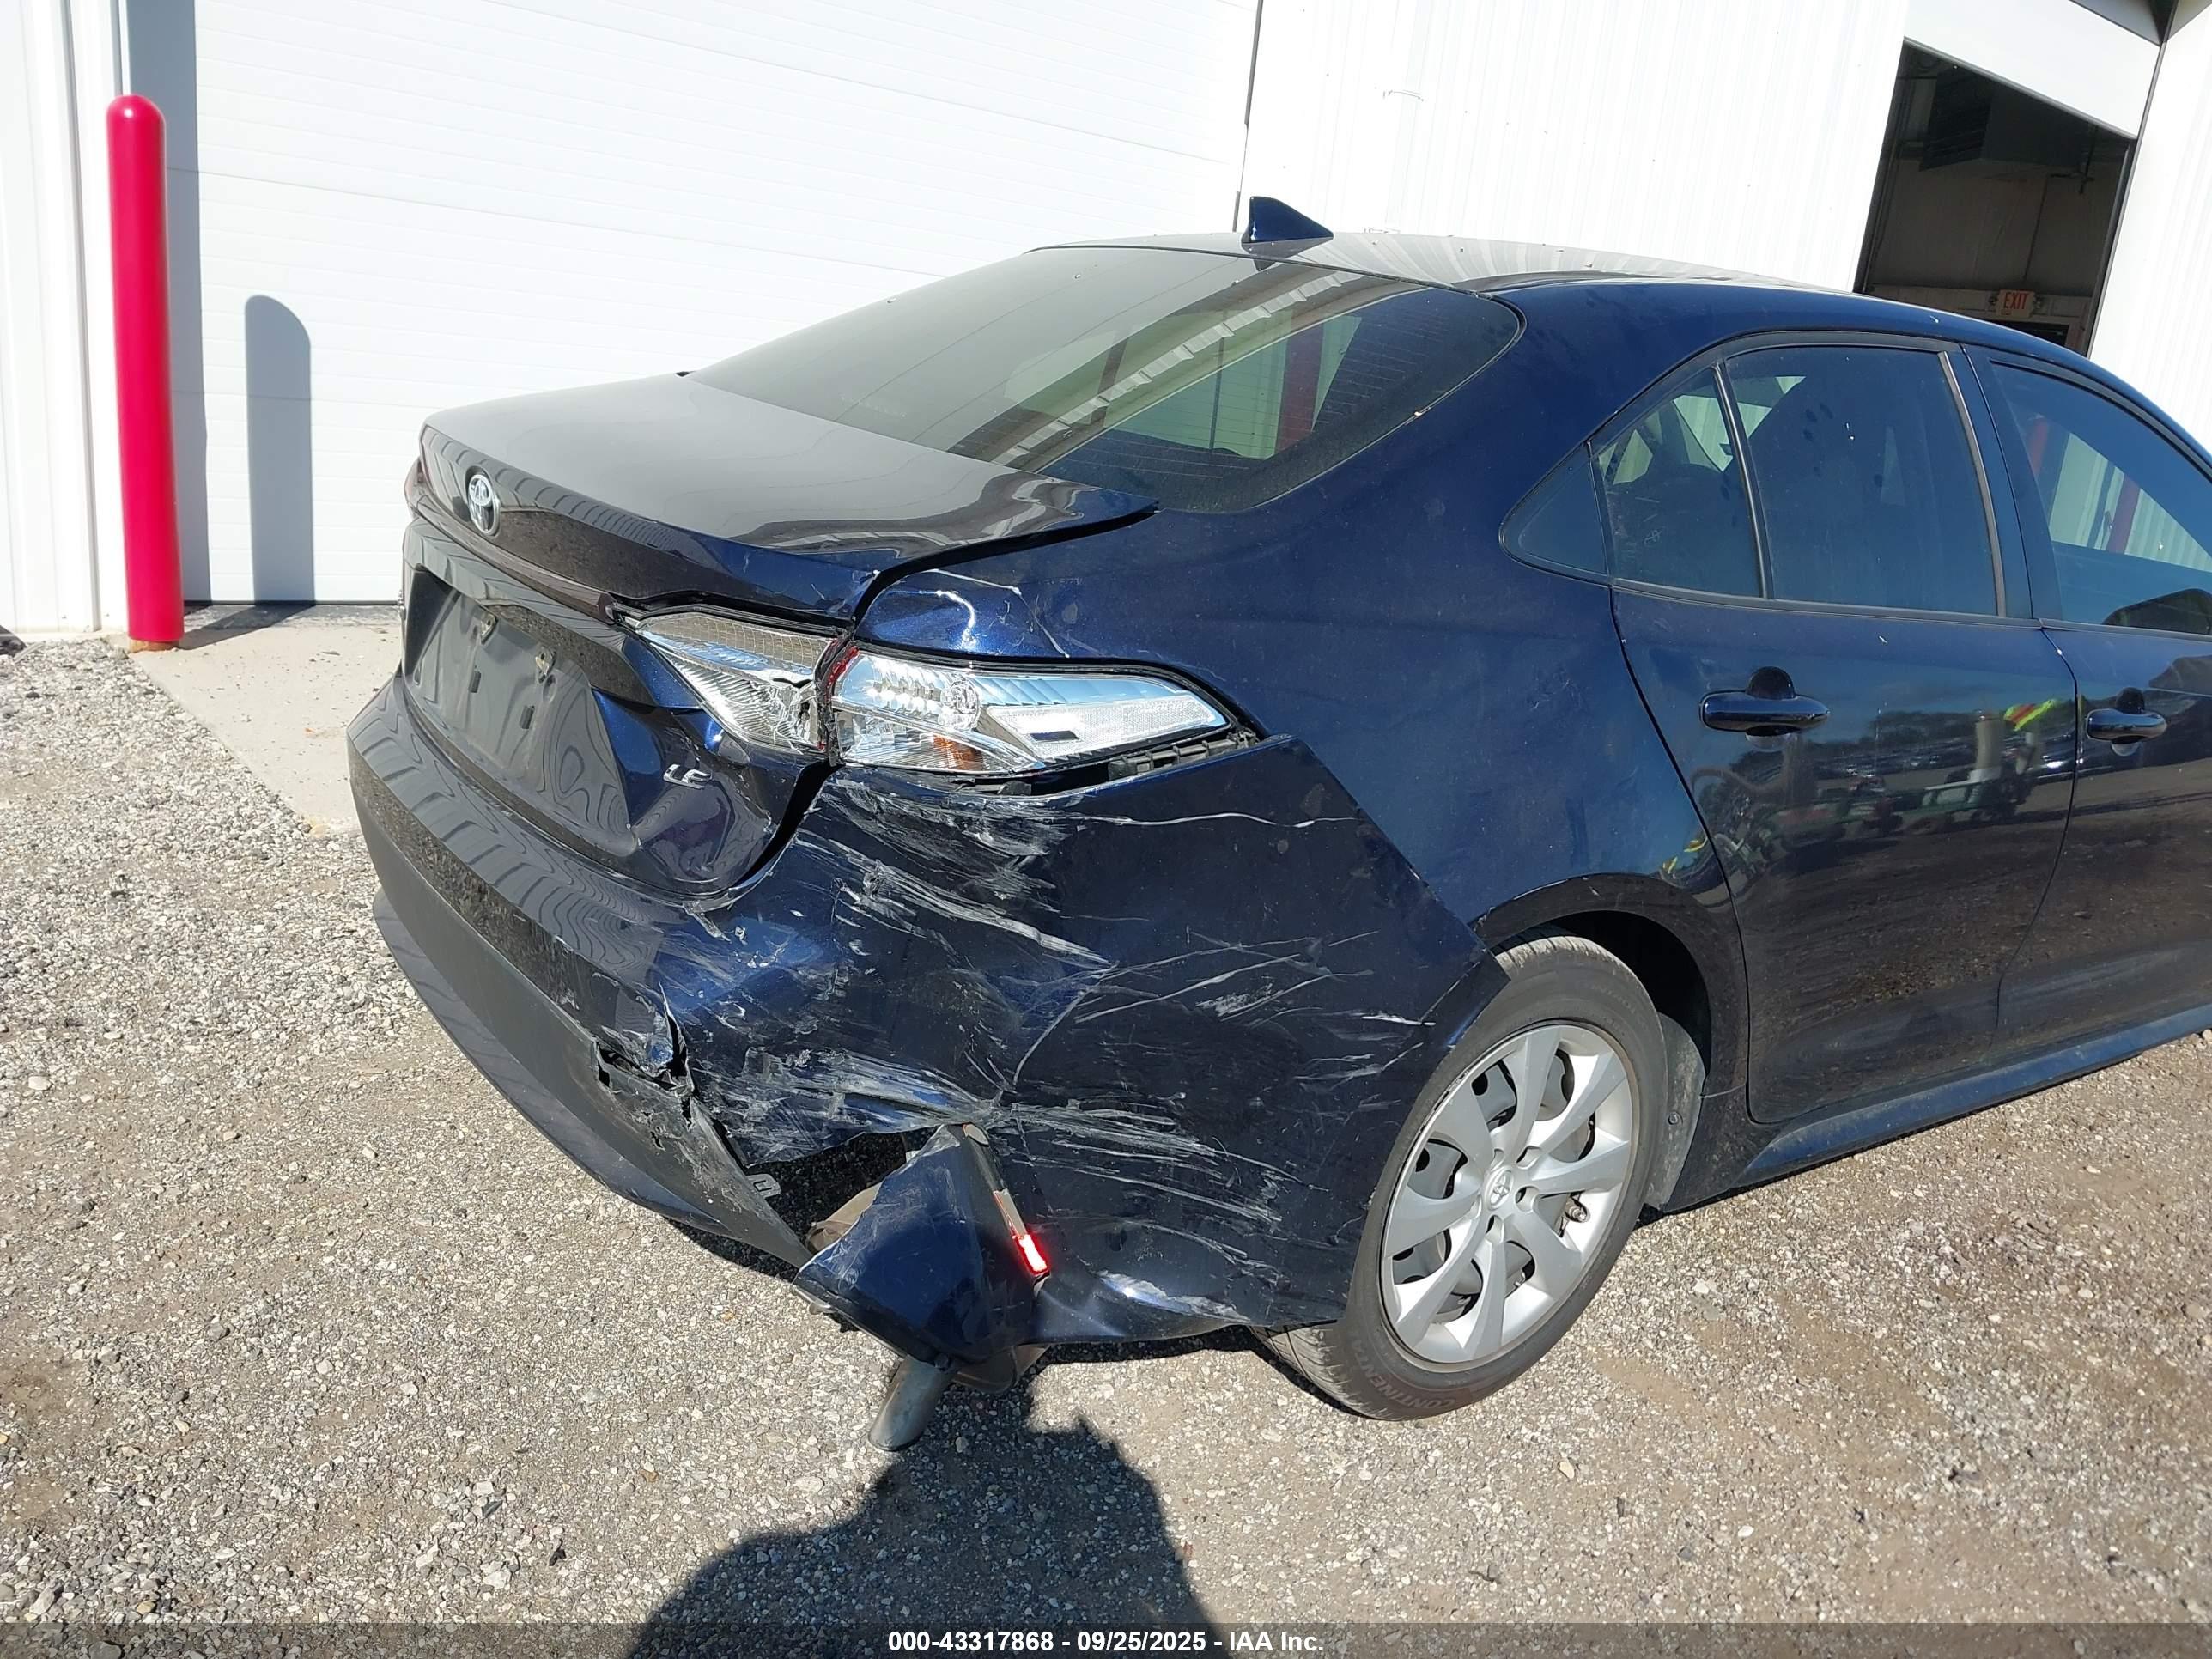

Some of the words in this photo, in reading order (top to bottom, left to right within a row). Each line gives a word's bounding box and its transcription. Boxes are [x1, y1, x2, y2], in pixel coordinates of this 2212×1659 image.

[2003, 292, 2029, 310] EXIT
[663, 763, 712, 790] LE
[1351, 1335, 1456, 1409] CONTINENTA
